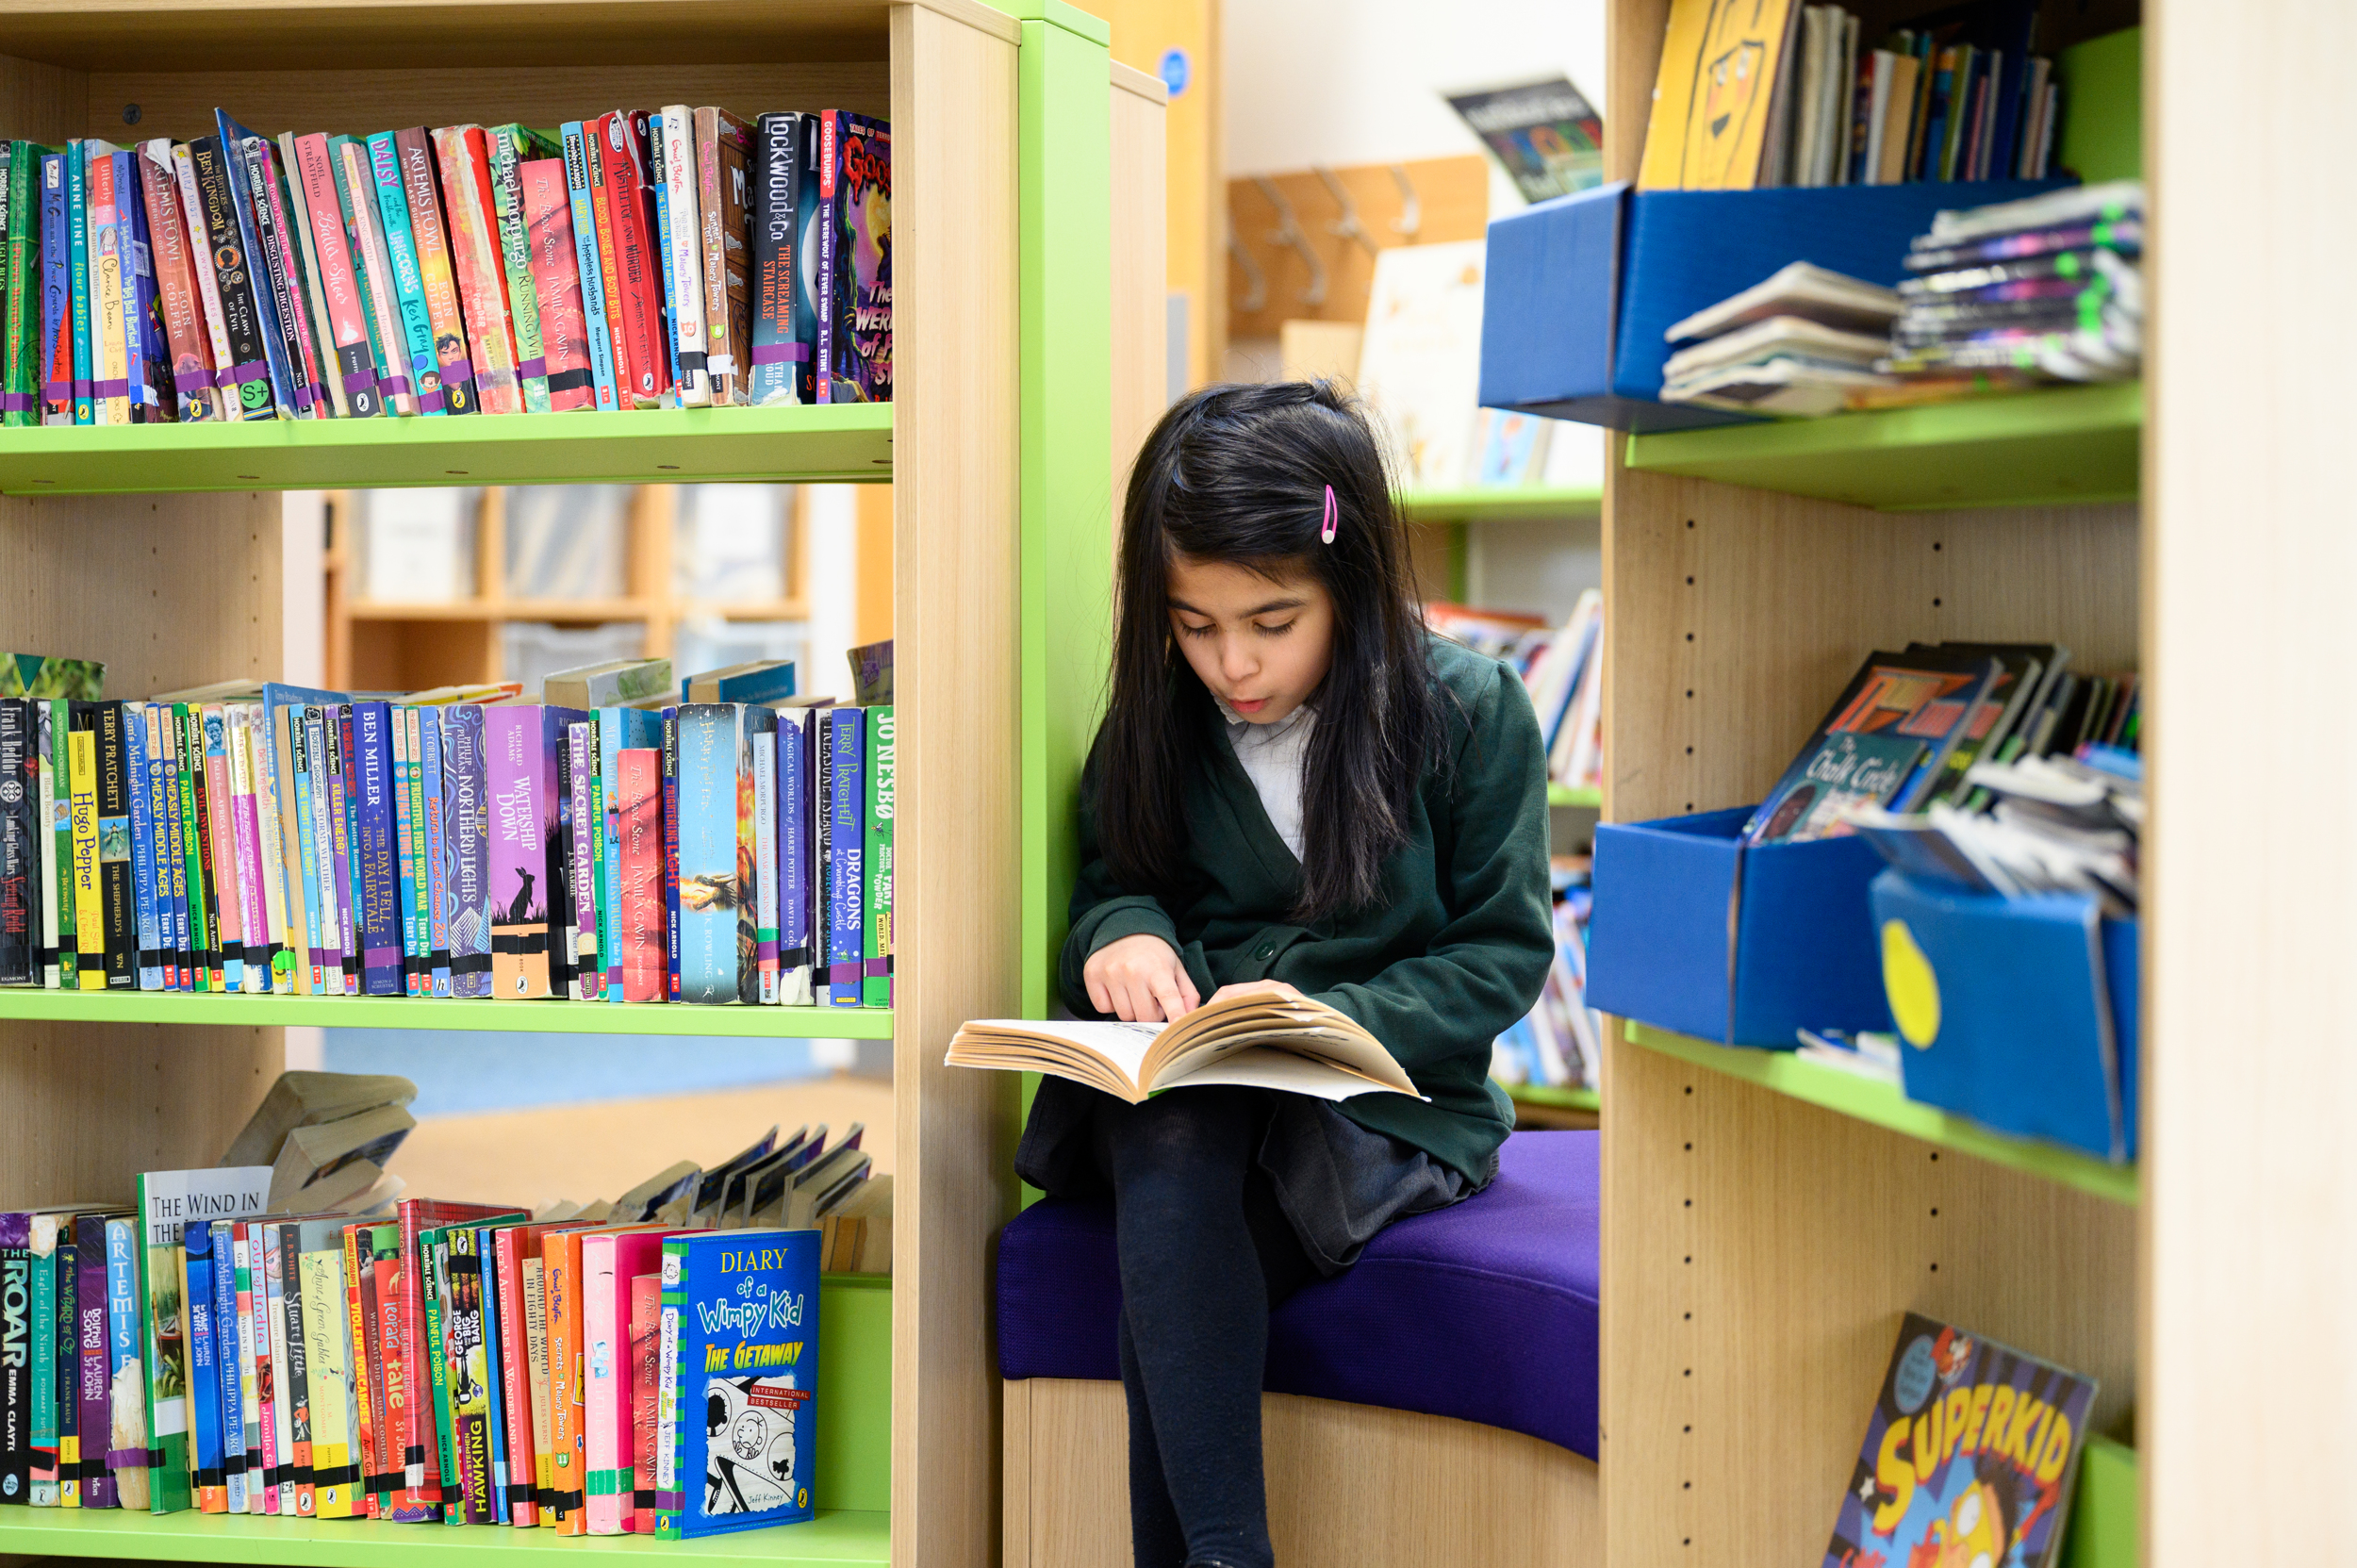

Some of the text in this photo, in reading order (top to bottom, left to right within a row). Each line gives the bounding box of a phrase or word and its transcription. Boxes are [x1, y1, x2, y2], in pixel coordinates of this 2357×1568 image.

[304, 141, 321, 197] STREATFEILD
[315, 157, 324, 179] NOEL
[371, 140, 400, 189] DAISY
[72, 174, 82, 246] ANNE FINE
[408, 147, 441, 257] ARTEMIS FOWL
[497, 133, 528, 269] michael morpurgo
[317, 211, 348, 305] Ballet Shoes
[600, 228, 612, 256] BONES
[603, 257, 614, 273] AND
[657, 191, 676, 308] THE TERRIBLE TRUTH ABOUT TIME
[821, 261, 829, 270] OF
[74, 263, 86, 332] flour babies
[103, 258, 119, 330] Clarice Bean
[200, 252, 217, 318] GWYNETH REES
[267, 236, 295, 341] DISGUSTING DIGESTION
[426, 273, 444, 330] COLFER
[440, 282, 453, 317] EOIN
[605, 276, 618, 298] BODY
[609, 300, 619, 319] BITS
[709, 254, 720, 311] Malory Towers
[762, 260, 774, 320] STAIRCASE
[776, 245, 790, 333] THE SCREAMING
[820, 272, 829, 294] FEVER
[820, 298, 829, 322] SWAMP
[123, 275, 140, 348] The Big Bad Blackout
[228, 303, 238, 331] OF EVIL
[239, 306, 250, 336] CLAWS
[403, 300, 430, 353] Kes Gray
[615, 345, 625, 374] ARNOLD
[1, 707, 23, 775] Frank Beddor
[507, 730, 516, 761] ADAMS
[572, 734, 585, 767] THE
[877, 713, 894, 740] JO
[103, 708, 119, 810] TERRY PRATCHETT
[364, 712, 380, 806] BEN MILLER
[836, 718, 858, 831] TERRY PRATCHETT
[43, 801, 52, 828] Beauty
[180, 780, 194, 854] PAINFUL POISON
[198, 788, 211, 870] EVIL INVENTIONS
[496, 793, 519, 841] DOWN
[513, 776, 536, 850] WATERSHIP
[575, 774, 586, 835] SECRET
[73, 792, 96, 890] Hugo Pepper
[166, 778, 183, 897] MEASLY MIDDLE AGES
[363, 827, 371, 850] INTO
[376, 828, 385, 847] THE
[377, 851, 387, 877] DAY
[458, 775, 476, 902] NORTHERN LIGHTS
[364, 863, 378, 933] FAIRYTALE
[379, 891, 392, 923] FELL
[632, 865, 645, 950] JAMILA GAVIN
[832, 858, 846, 931] Crumbling Castle
[848, 849, 860, 930] DRAGONS
[153, 1192, 259, 1218] THE WIND IN
[154, 1224, 179, 1243] THE
[720, 1247, 788, 1273] DIARY
[737, 1276, 766, 1296] of a
[2, 1261, 28, 1367] ROAR
[38, 1269, 49, 1363] Eagle of the Ninth
[284, 1291, 305, 1378] Stuart Little
[313, 1268, 329, 1364] Anne Green Gables
[453, 1311, 463, 1355] GEORGE
[471, 1311, 480, 1344] BANG
[495, 1235, 518, 1444] ALICE'S ADVENTURES IN WONDERLAND
[527, 1294, 539, 1362] EIGHTY DAYS
[697, 1290, 803, 1337] Wimpy Kid
[351, 1302, 370, 1425] VIOLENT VOLCANOES
[663, 1312, 674, 1389] Diary Wimpy Kid
[704, 1340, 803, 1373] THE GETAWAY
[8, 1369, 16, 1406] EMMA
[555, 1337, 567, 1440] Secrets Malory Towers
[750, 1398, 799, 1409] BESTSELLER
[751, 1386, 808, 1399] INTERNATIONAL
[473, 1421, 486, 1512] HAWKING
[662, 1454, 670, 1485] KINNEY
[1871, 1384, 2071, 1537] SUPERKID
[747, 1493, 784, 1504] Jeff Kinney
